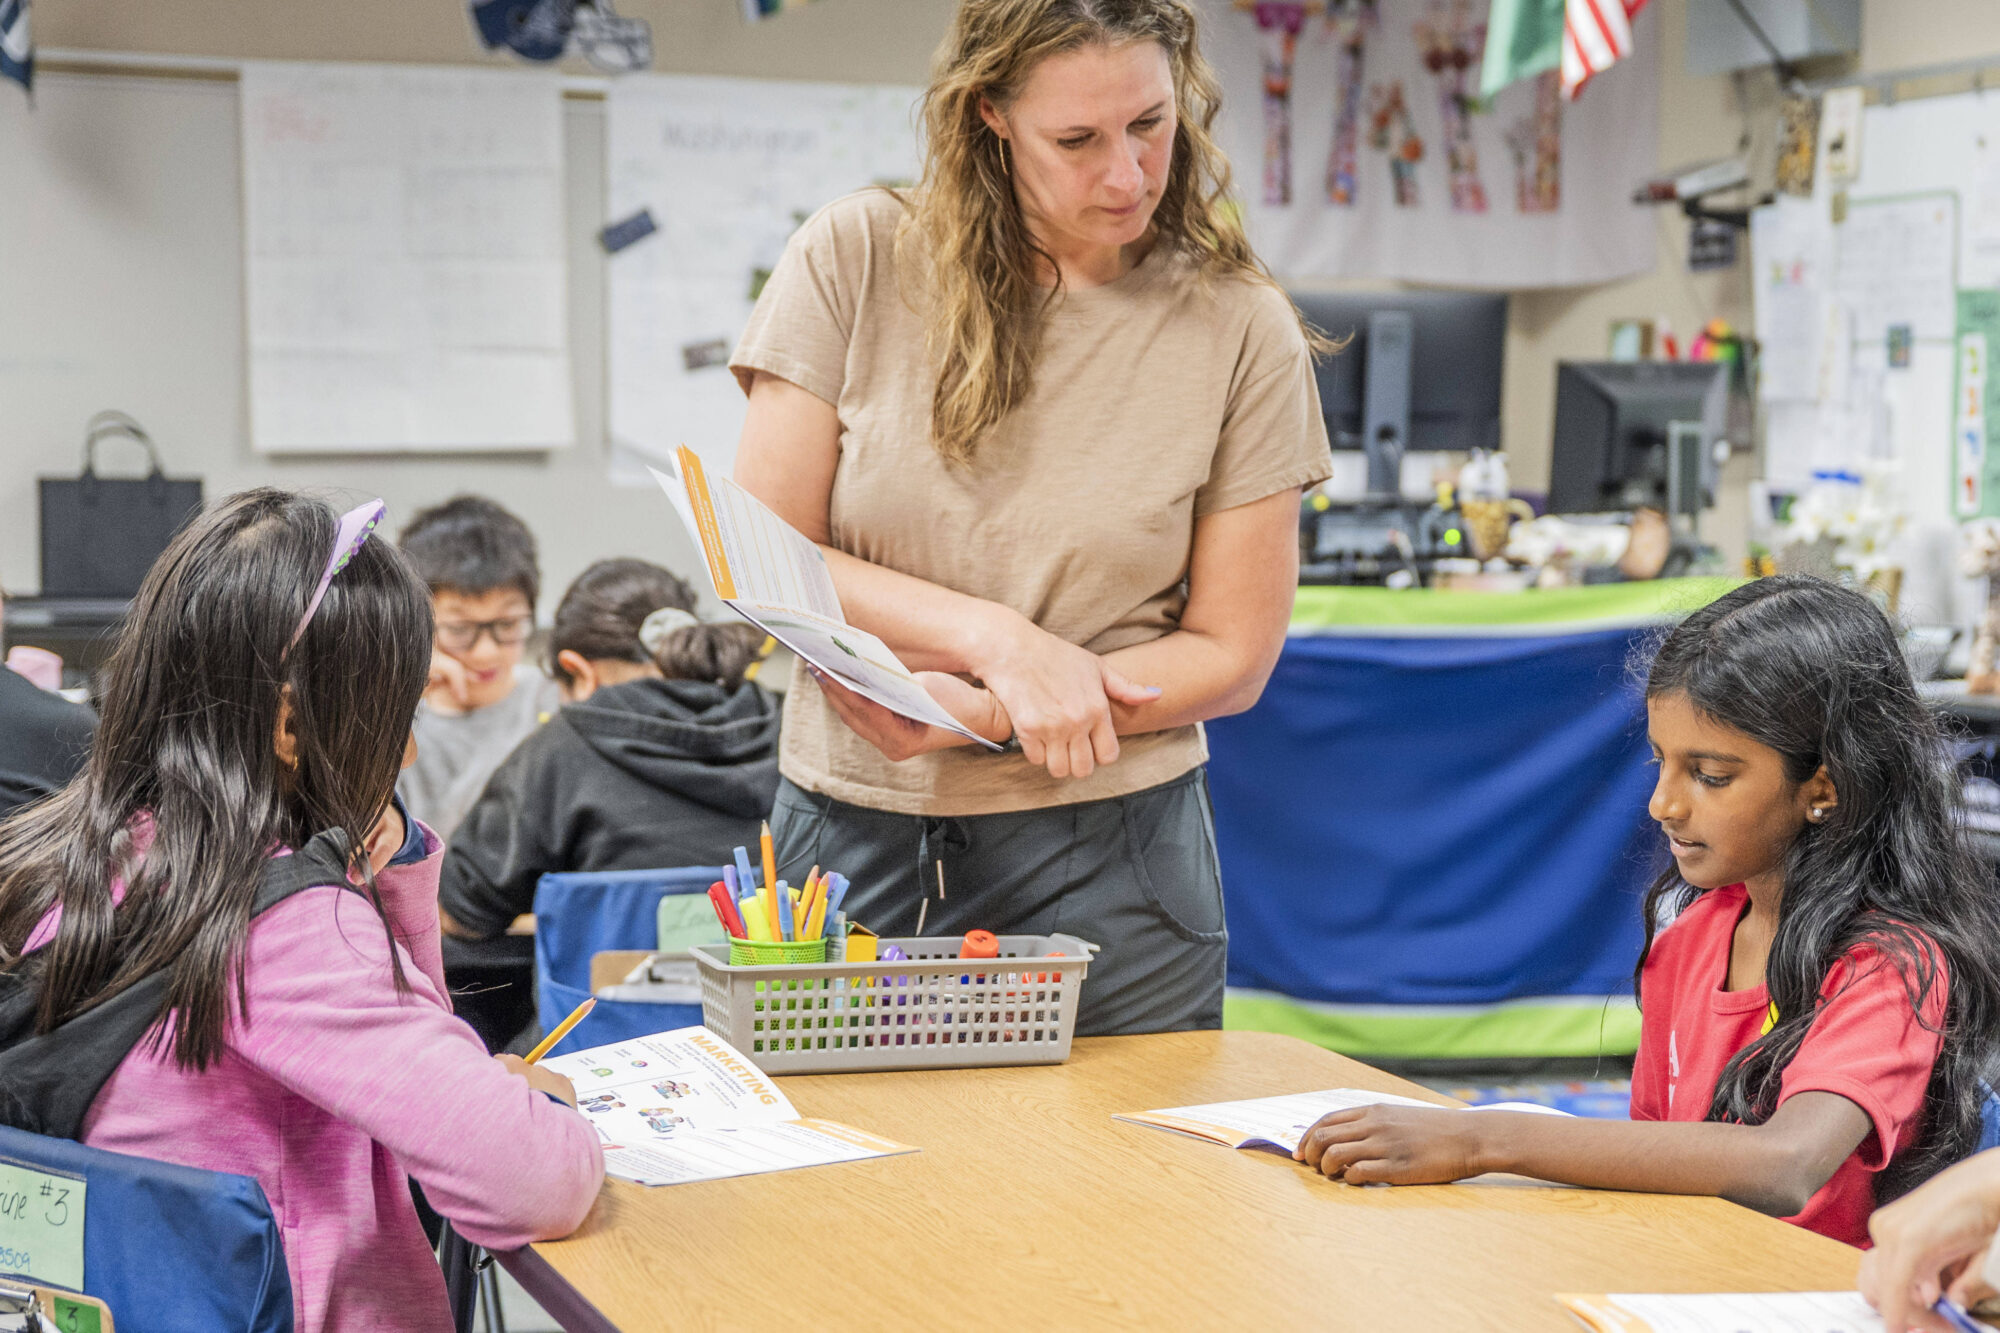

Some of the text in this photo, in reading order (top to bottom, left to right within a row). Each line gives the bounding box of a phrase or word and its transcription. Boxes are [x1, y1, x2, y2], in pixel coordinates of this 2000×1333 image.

[688, 1035, 778, 1106] MARKETING
[40, 1179, 70, 1227] #3
[66, 1306, 79, 1333] 3
